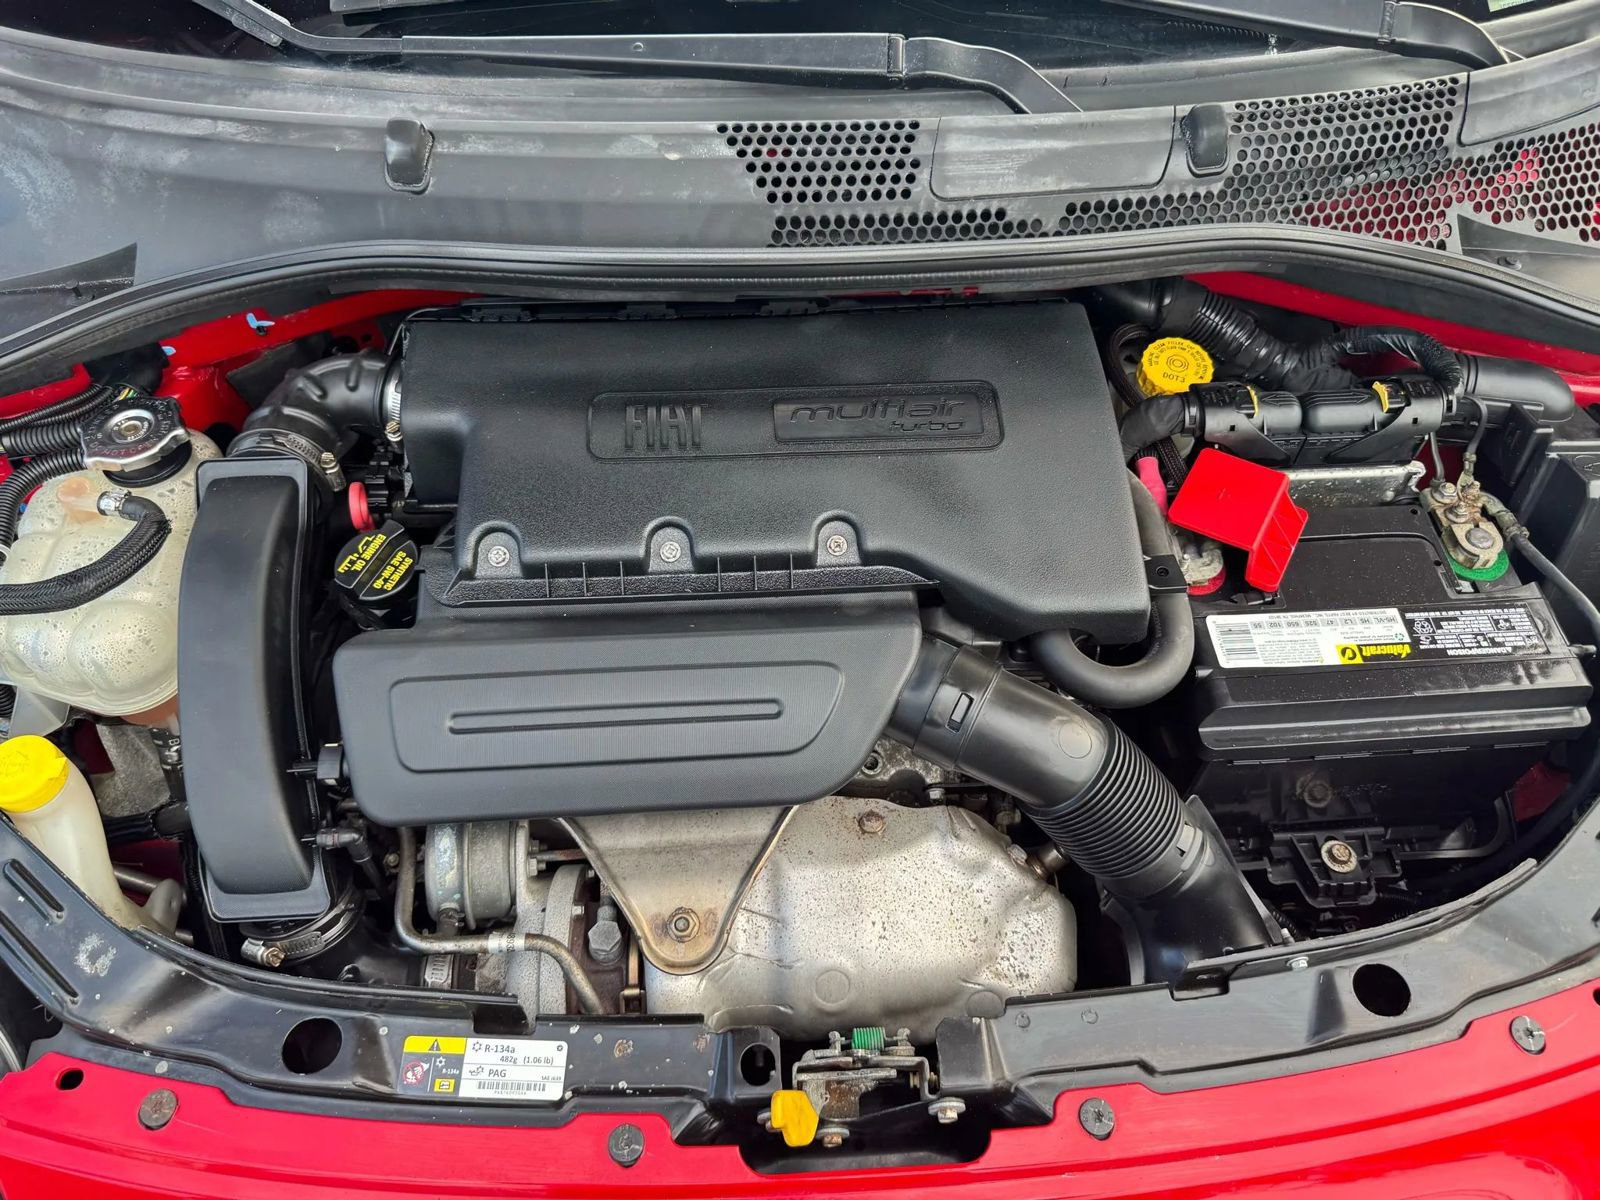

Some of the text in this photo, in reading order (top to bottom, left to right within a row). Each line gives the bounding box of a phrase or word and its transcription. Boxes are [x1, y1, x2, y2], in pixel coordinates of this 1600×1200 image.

[1162, 371, 1186, 383] DOT3
[789, 397, 966, 423] multiair
[624, 403, 708, 449] FIAT
[887, 419, 965, 433] turbo
[351, 533, 387, 572] ENGINE OIL
[390, 551, 407, 566] SAE
[383, 557, 413, 591] SYNTHETIC
[484, 1044, 516, 1053] R-134a
[499, 1055, 554, 1065] 482g (1.06 lb)
[488, 1068, 507, 1078] PAG
